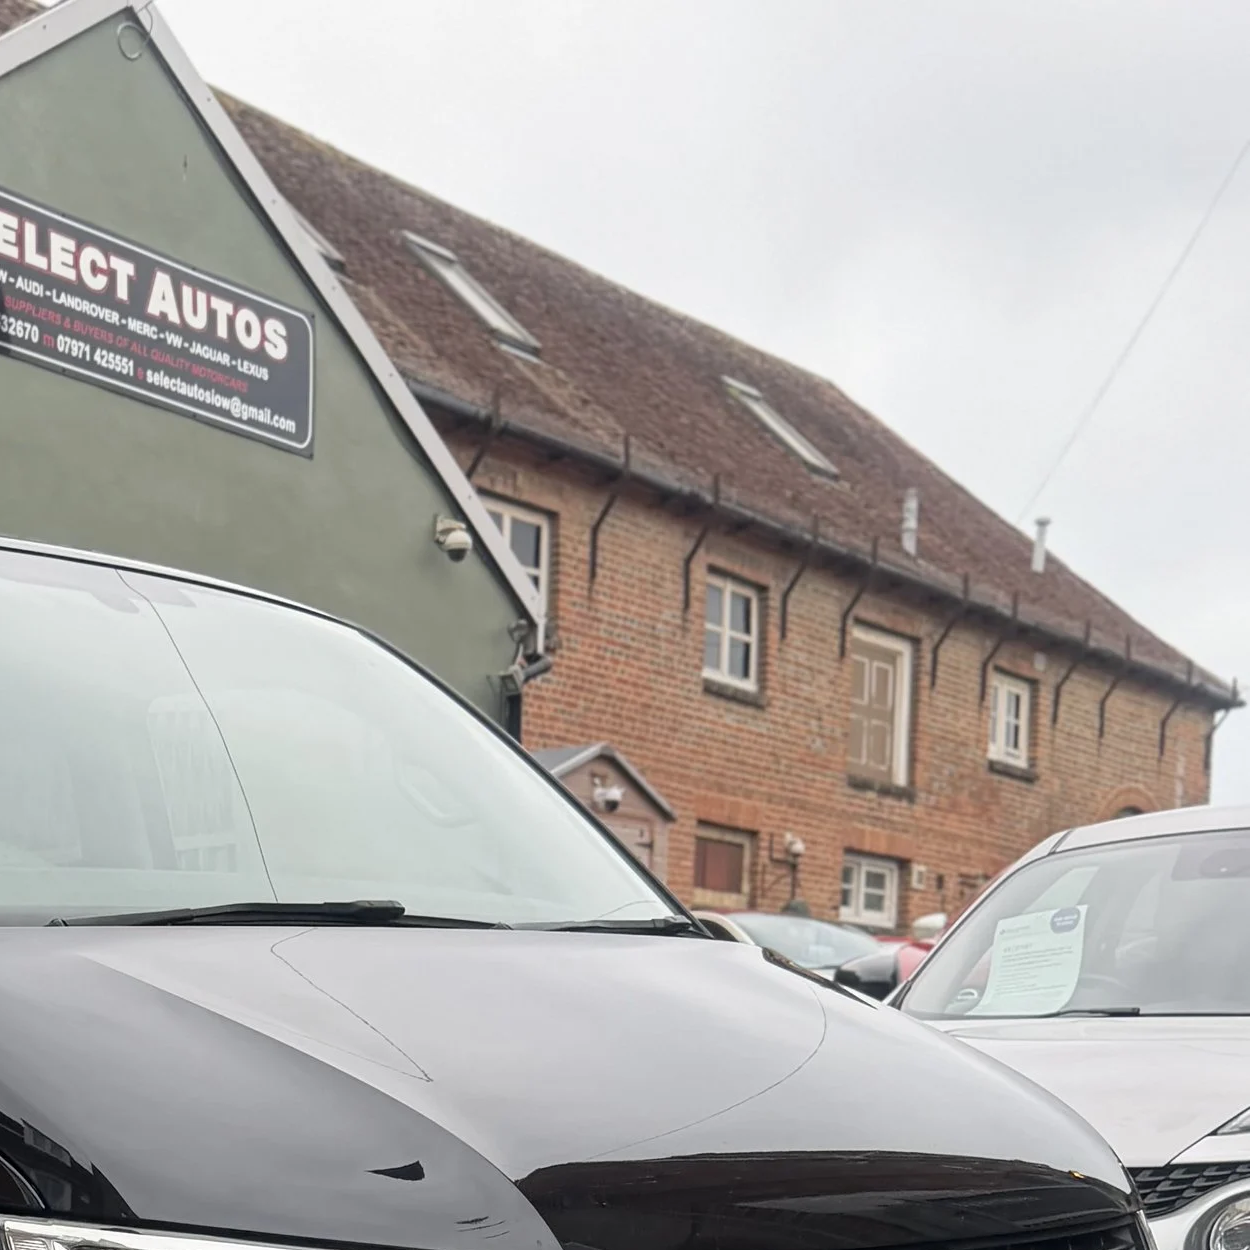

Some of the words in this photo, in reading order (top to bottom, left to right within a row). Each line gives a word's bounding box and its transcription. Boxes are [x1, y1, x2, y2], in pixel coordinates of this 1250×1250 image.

[4, 295, 62, 326] SUPPLIERS
[63, 317, 71, 329] &
[73, 319, 114, 345] BUYERS
[116, 334, 130, 348] OF
[131, 340, 148, 357] ALL
[150, 349, 190, 373] QUALITY
[191, 364, 249, 393] MOTORCARS
[15, 276, 43, 297] AUDI
[52, 289, 120, 326] LANDROVER
[127, 317, 158, 340] MERC
[165, 331, 183, 349] VW
[189, 341, 231, 367] JAGUAR
[237, 358, 269, 381] LEXUS
[147, 270, 289, 361] AUTOS
[43, 333, 54, 349] m
[57, 334, 91, 362] 07971
[93, 347, 134, 377] 425551
[146, 365, 296, 433] selectautosiow@gmail.com
